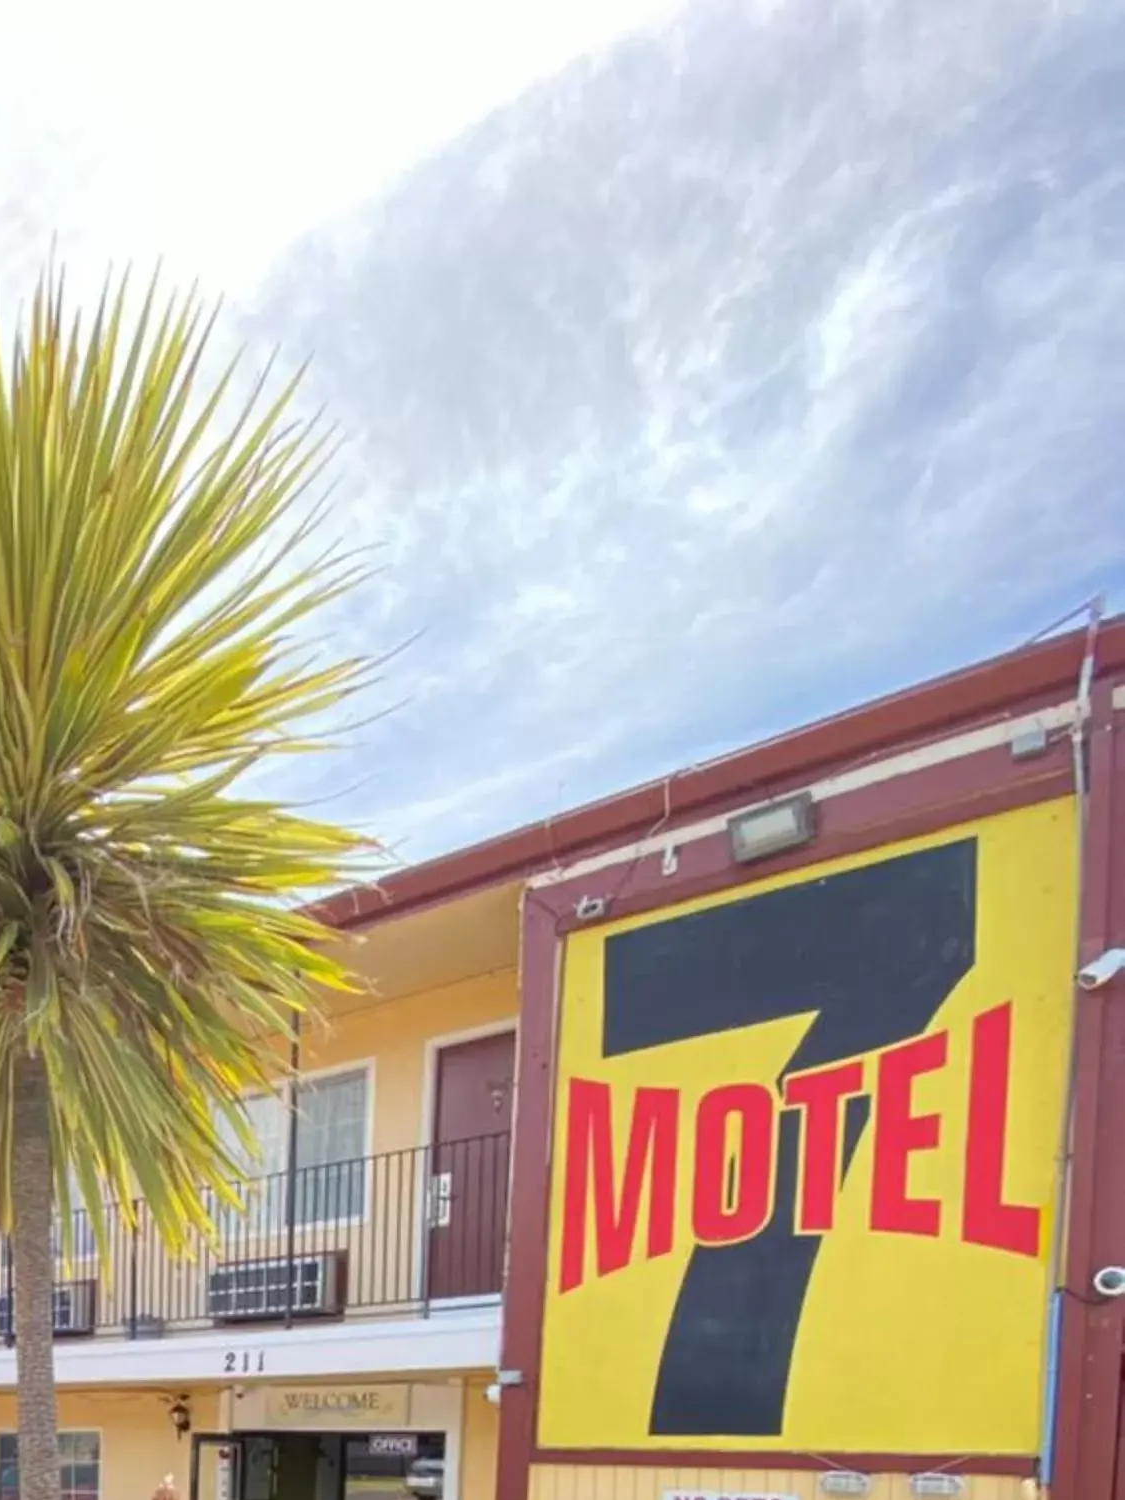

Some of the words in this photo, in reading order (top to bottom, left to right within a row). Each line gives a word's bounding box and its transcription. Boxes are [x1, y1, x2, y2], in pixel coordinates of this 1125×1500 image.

[559, 1001, 1041, 1295] MOTEL
[603, 835, 978, 1436] 7
[224, 1351, 265, 1372] 211
[285, 1393, 381, 1409] WELCOME
